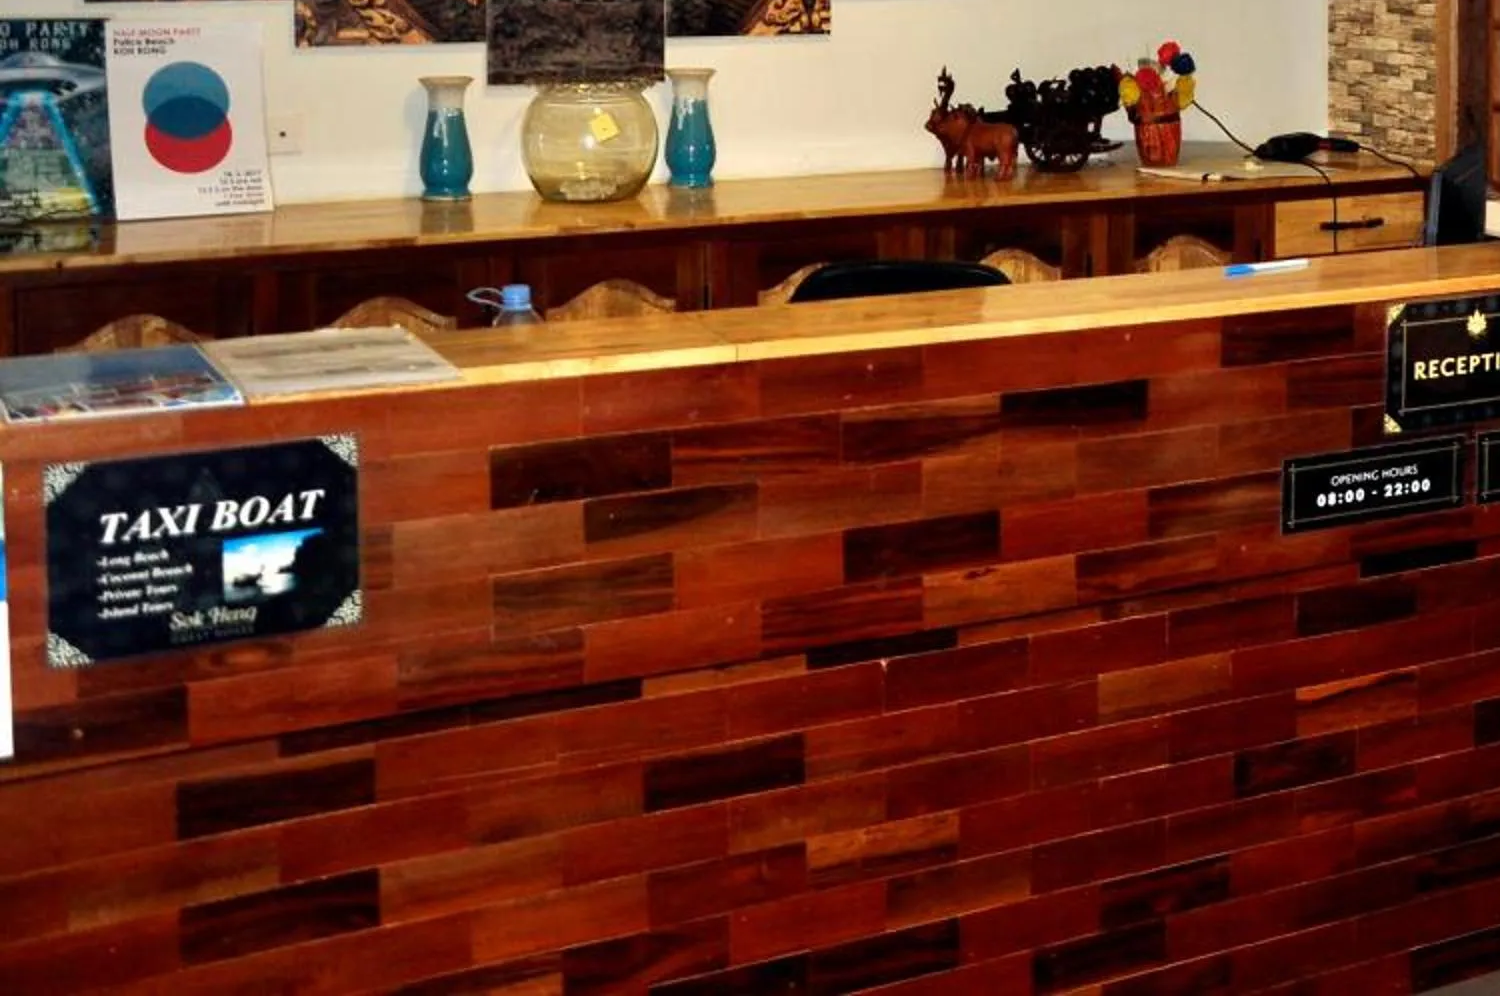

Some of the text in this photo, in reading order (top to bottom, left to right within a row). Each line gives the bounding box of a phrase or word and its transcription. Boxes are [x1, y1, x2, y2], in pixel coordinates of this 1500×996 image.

[25, 21, 88, 38] PARTY
[0, 37, 19, 51] OH
[1330, 464, 1419, 487] OPENING HOURS
[1316, 488, 1366, 507] 08:00
[1383, 478, 1431, 499] 22:00
[100, 489, 326, 545] TAXI BOAT
[133, 548, 169, 563] Beach
[146, 584, 178, 596] Tours
[142, 602, 173, 613] Tours
[168, 610, 204, 631] Sok
